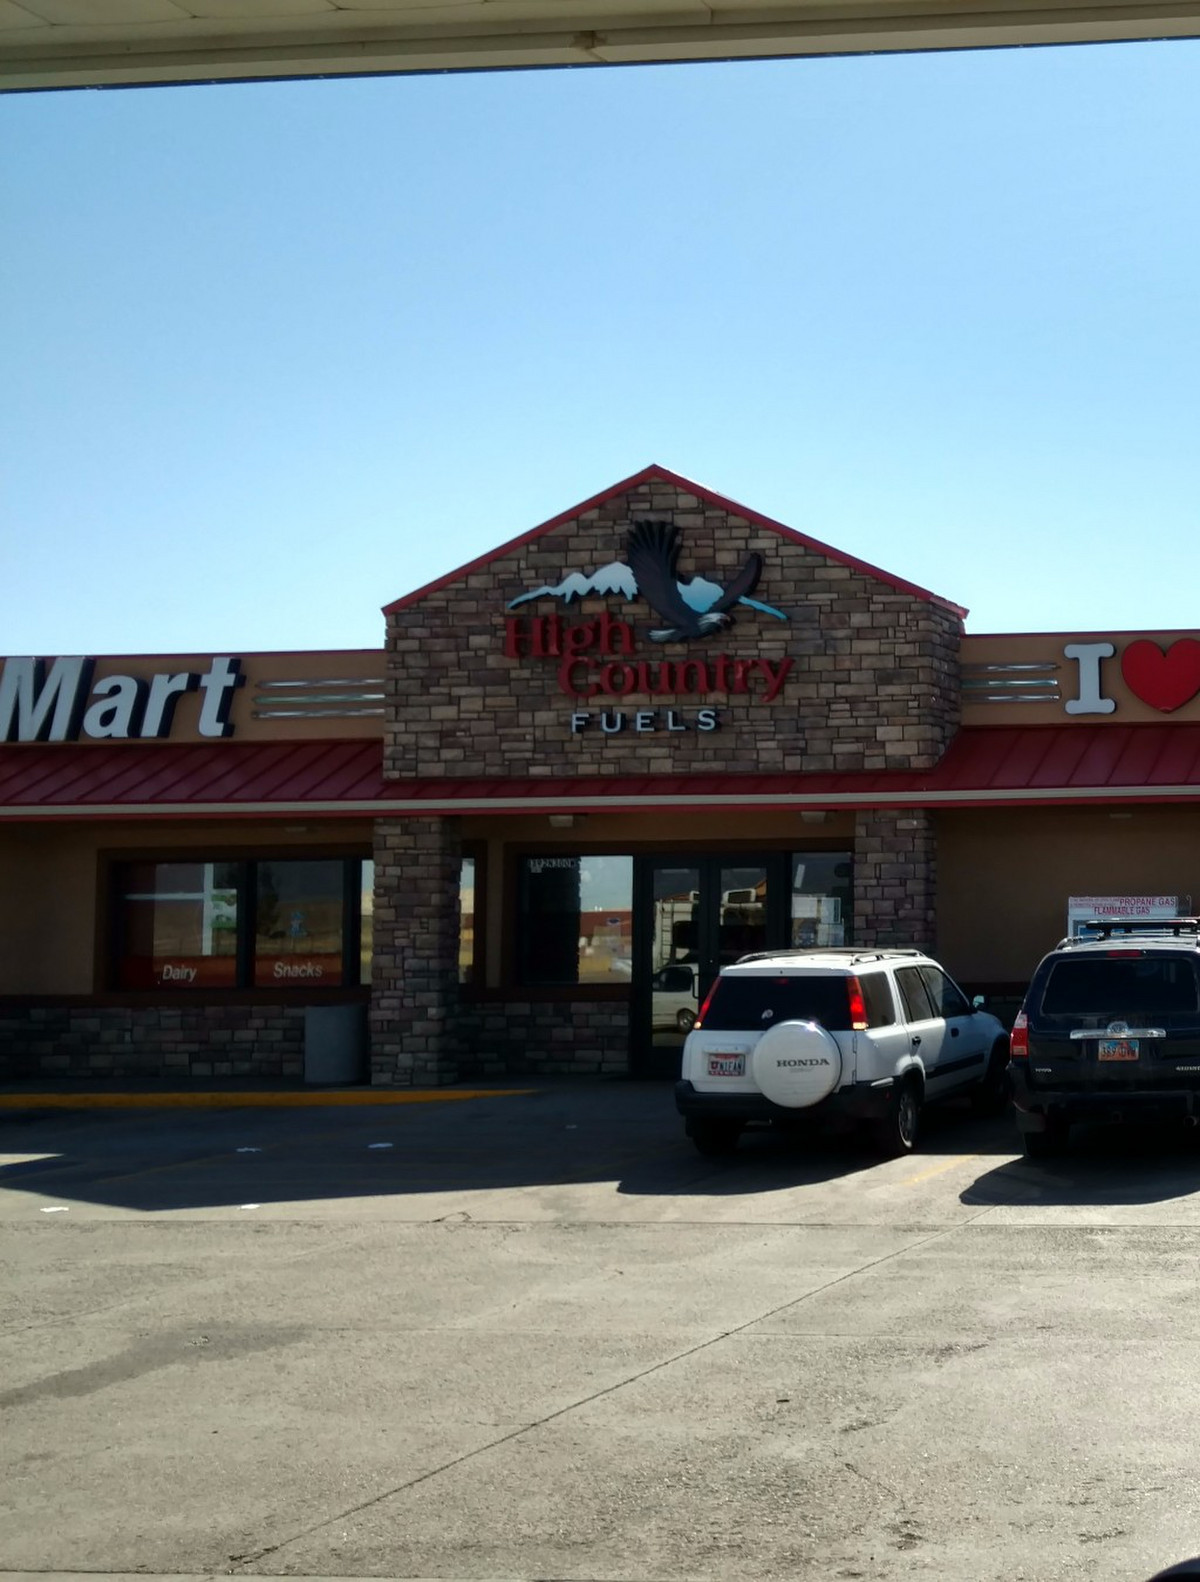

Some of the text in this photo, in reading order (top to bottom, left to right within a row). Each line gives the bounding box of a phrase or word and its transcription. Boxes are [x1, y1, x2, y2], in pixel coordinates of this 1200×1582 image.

[505, 611, 635, 657] High
[558, 653, 795, 702] Country
[1064, 642, 1115, 715] I
[0, 657, 241, 741] Mart
[571, 711, 718, 733] FUELS
[1094, 906, 1151, 915] FLAMMABLE GAS
[1120, 898, 1156, 906] PROPANE
[1158, 898, 1176, 906] GAS
[162, 964, 197, 982] Dairy
[273, 961, 323, 979] Snacks
[776, 1058, 830, 1067] HONDA
